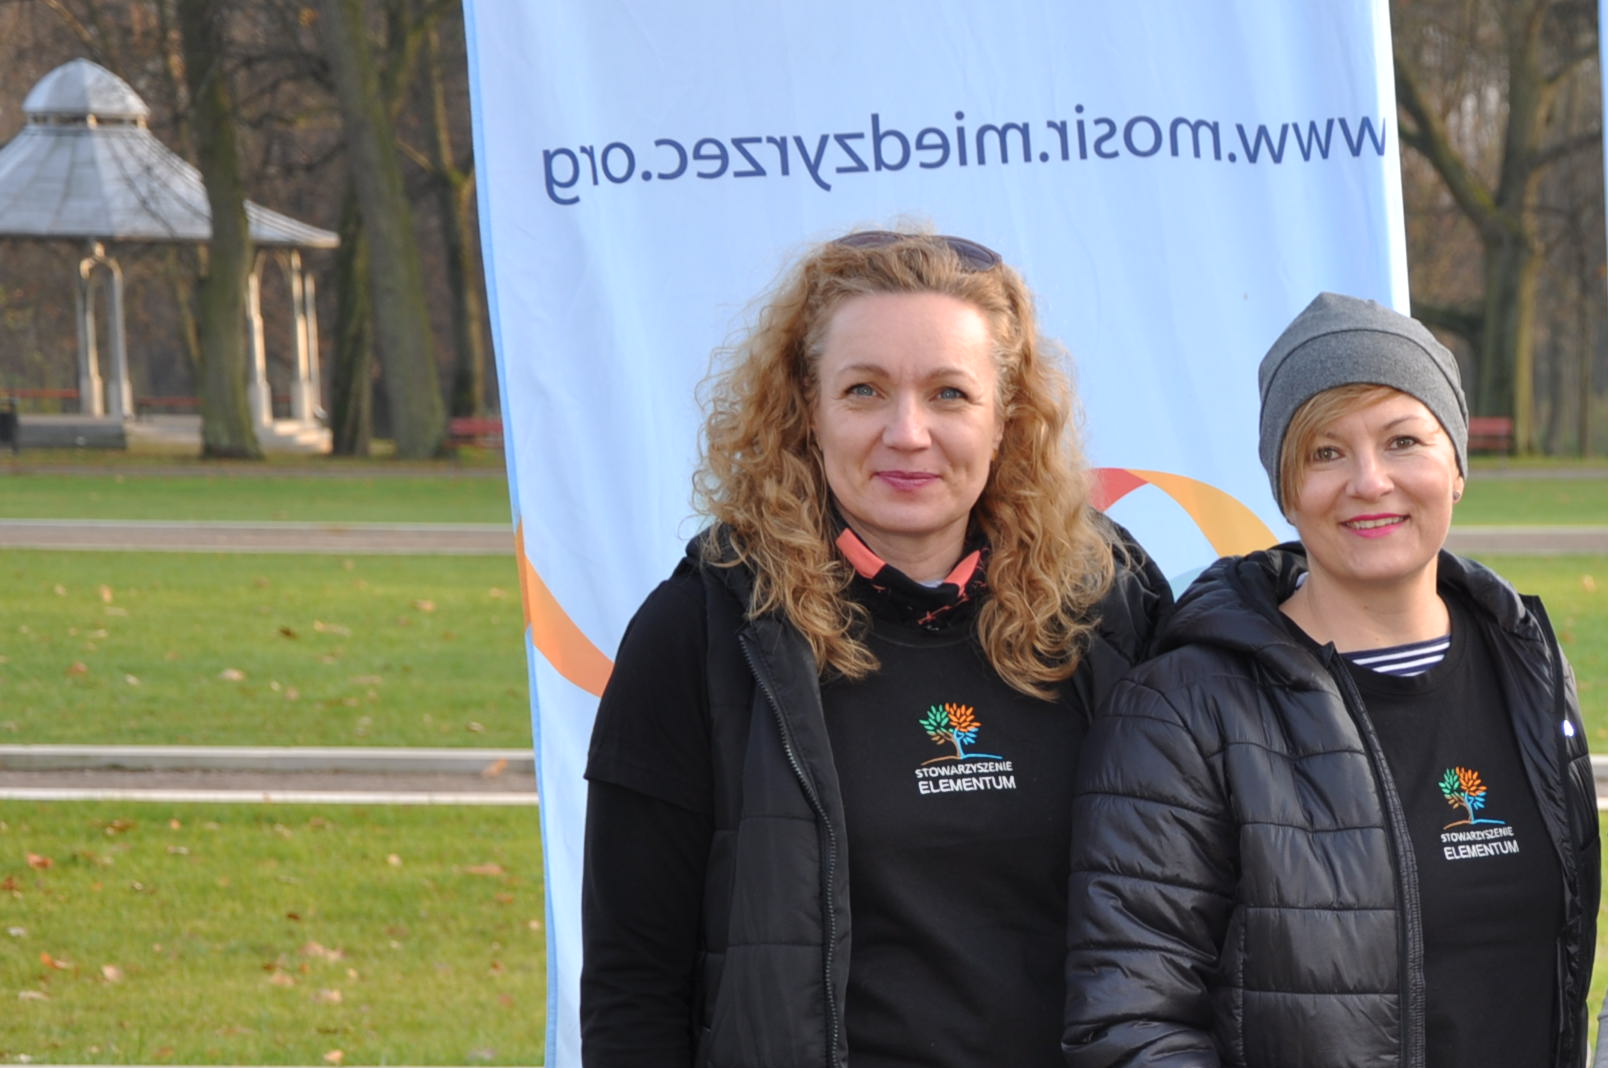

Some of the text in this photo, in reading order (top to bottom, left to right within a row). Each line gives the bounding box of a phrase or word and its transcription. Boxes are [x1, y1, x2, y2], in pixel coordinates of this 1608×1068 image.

[914, 761, 1014, 778] STOWARZYSZENIE
[918, 775, 1017, 794] ELEMENTUM
[1440, 826, 1514, 843] STOWARZYSZENIE
[1443, 839, 1520, 861] ELEMENTUM
